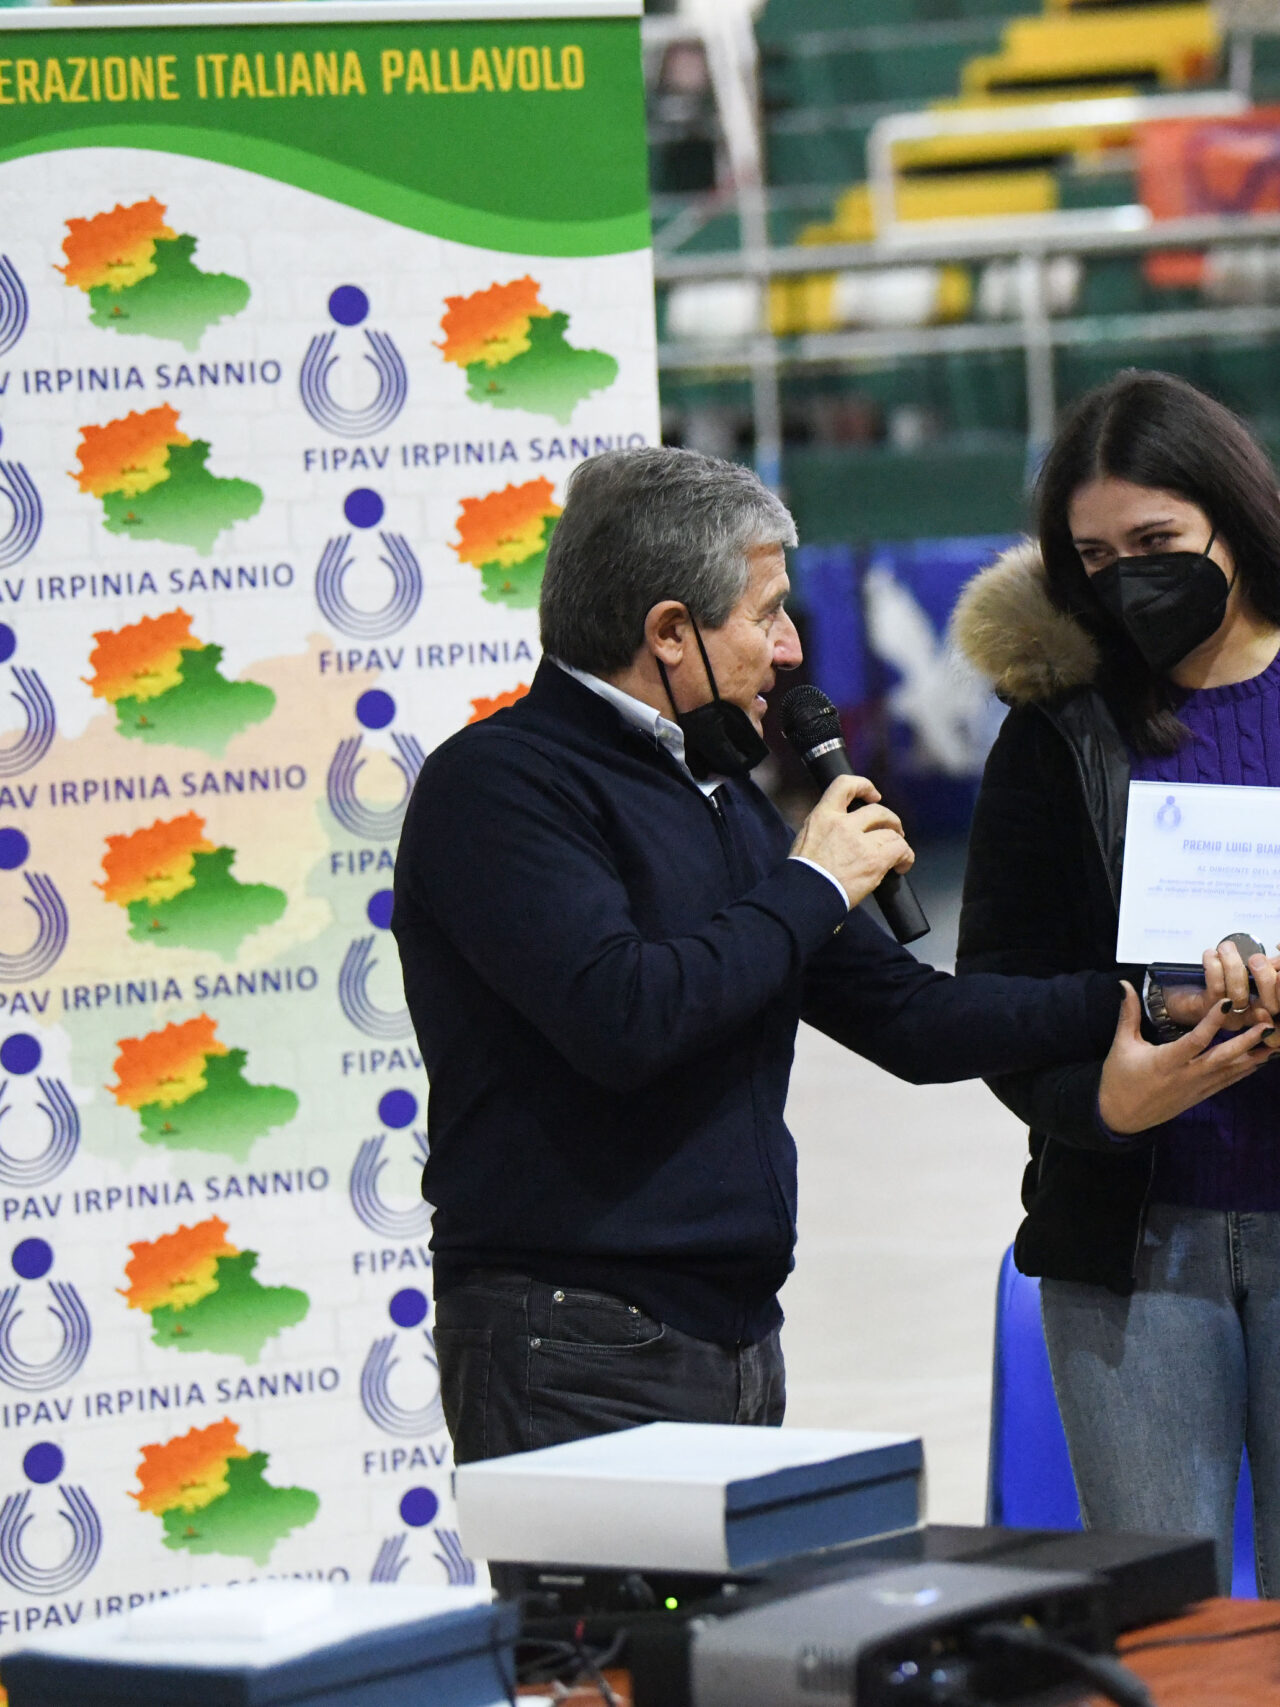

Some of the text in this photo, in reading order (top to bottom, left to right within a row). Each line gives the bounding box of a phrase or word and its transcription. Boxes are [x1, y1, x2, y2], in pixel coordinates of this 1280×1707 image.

[0, 44, 586, 105] ERAZIONE ITALIANA PALLAVOLO
[23, 365, 145, 395] IRPINIA
[155, 359, 282, 389] SANNIO
[303, 445, 391, 472] FIPAV
[402, 438, 519, 468] IRPINIA
[37, 570, 159, 601] IRPINIA
[168, 562, 295, 593] SANNIO
[318, 639, 533, 674] FIPAV IRPINIA
[50, 774, 171, 807] IRPINIA
[181, 764, 307, 797] SANNIO
[331, 847, 398, 875] FIPA
[1183, 839, 1222, 852] PREMIO
[1226, 841, 1253, 853] LUIGI
[62, 977, 183, 1011] IRPINIA
[193, 966, 318, 1000] SANNIO
[3, 1167, 330, 1223] PAV IRPINIA SANNIO
[3, 1367, 340, 1429] IPAV IRPINIA SANNIO
[364, 1444, 447, 1475] FIPAV
[0, 1601, 84, 1636] FIPAV
